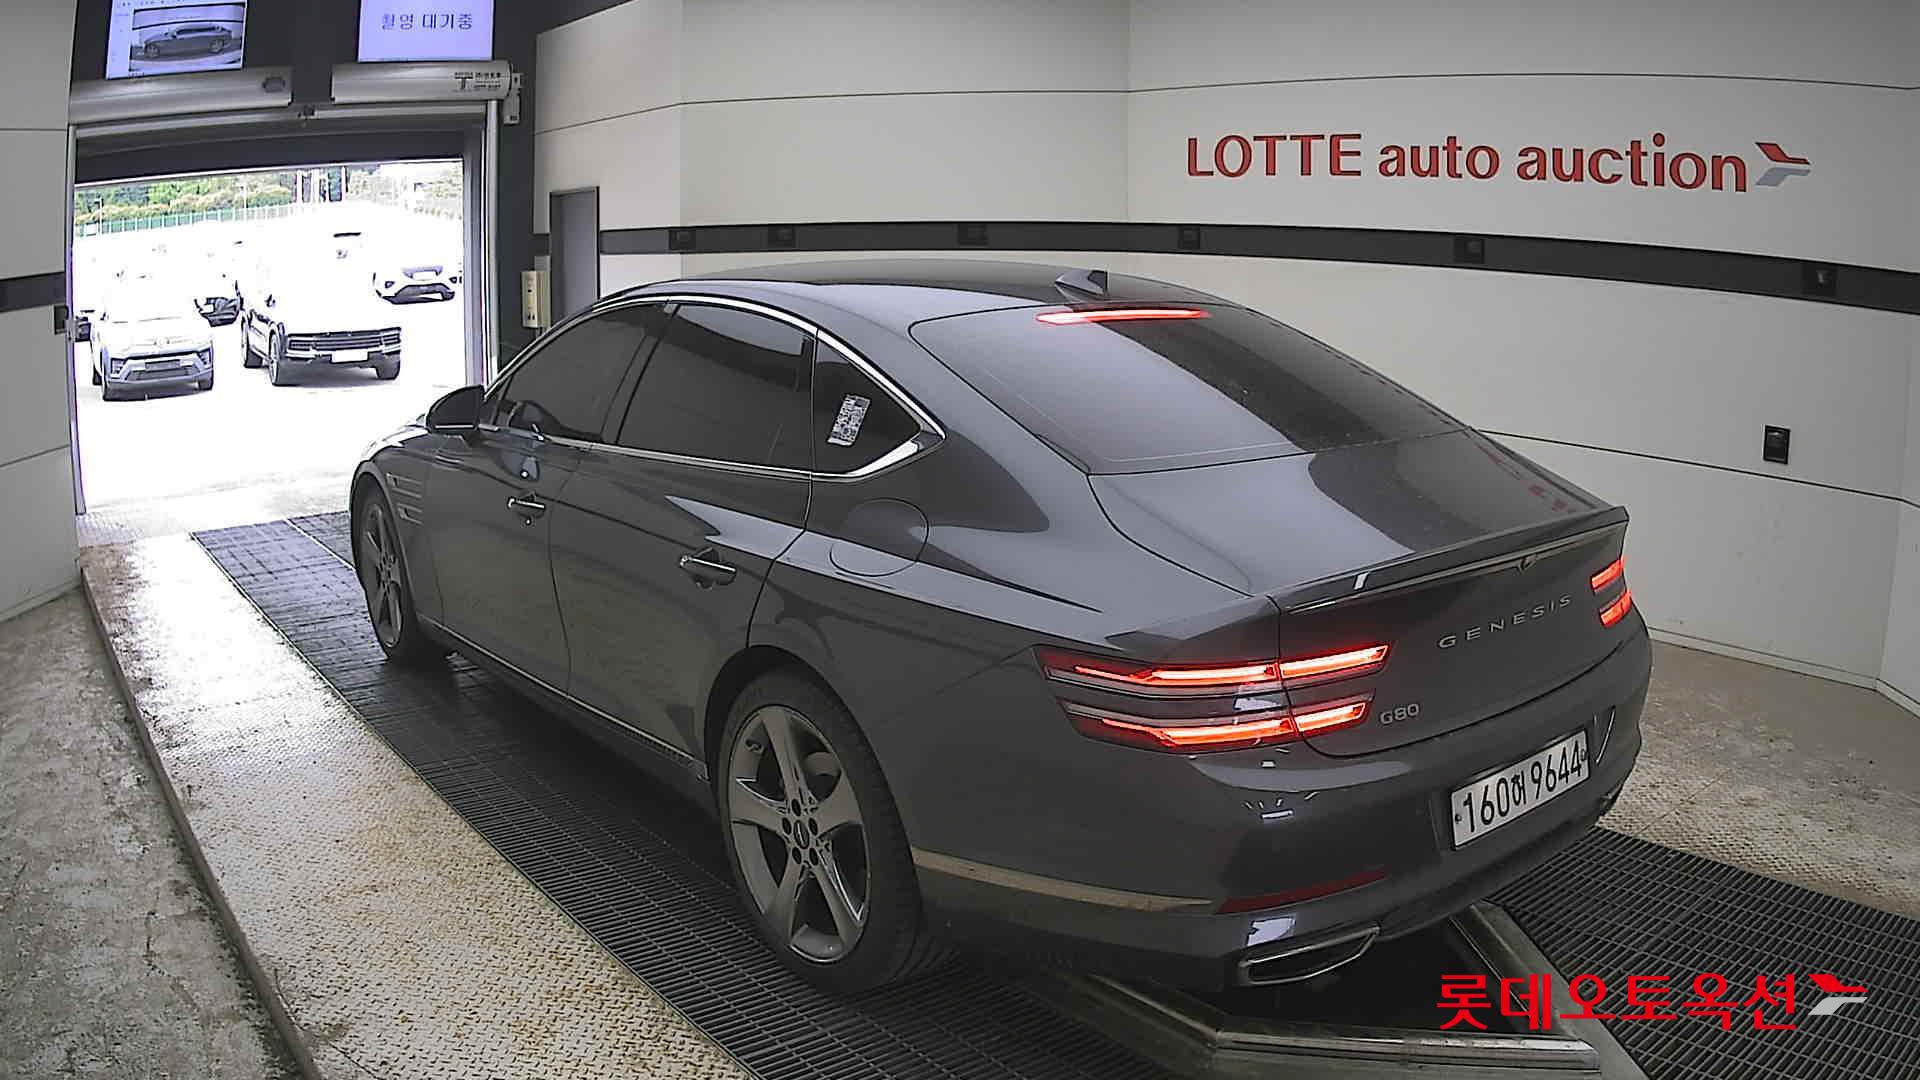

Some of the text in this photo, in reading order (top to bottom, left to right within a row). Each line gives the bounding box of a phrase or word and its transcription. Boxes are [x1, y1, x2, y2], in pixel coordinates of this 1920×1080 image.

[422, 13, 473, 30] 대기중
[1187, 132, 1747, 193] LOTTE auto auction
[1438, 594, 1571, 648] GENESIS
[1380, 703, 1420, 725] G80
